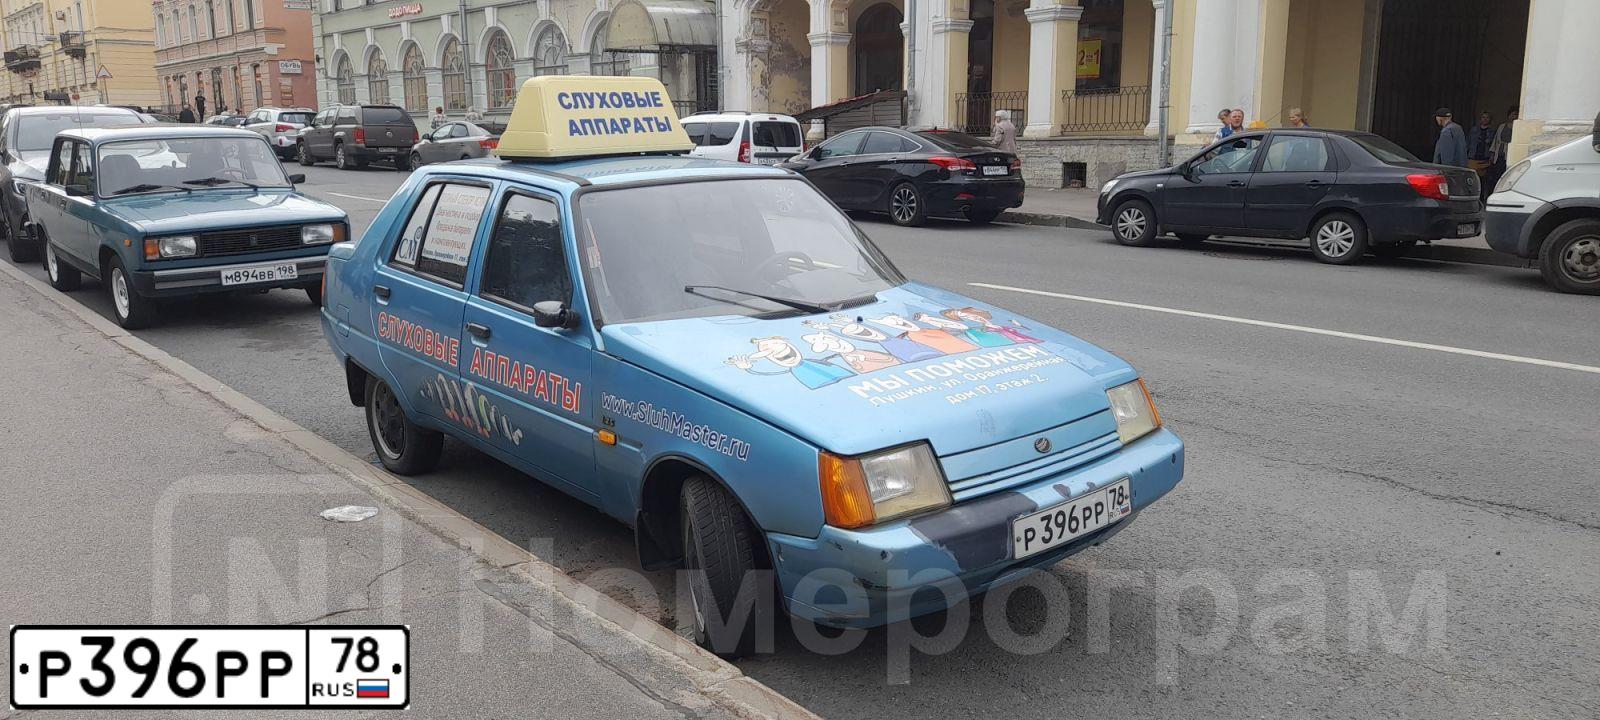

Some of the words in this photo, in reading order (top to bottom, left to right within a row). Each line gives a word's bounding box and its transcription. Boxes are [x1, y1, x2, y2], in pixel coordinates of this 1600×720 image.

[280, 61, 301, 69] ОБУВЬ
[1078, 49, 1086, 66] 2
[557, 91, 664, 110] СЛУХОВЫЕ
[568, 116, 673, 137] АППАРАТЫ
[225, 269, 275, 284] М894ВВ
[276, 265, 294, 275] 198
[378, 311, 460, 367] СЛУХОВЫЕ
[470, 346, 582, 414] АППАРАТЫ
[848, 373, 911, 398] МЫ
[904, 345, 1049, 383] ПОМОЖЕМ
[869, 383, 944, 407] Пушкин,
[941, 377, 967, 389] ул.
[963, 356, 1065, 381] Оранжерейная
[996, 376, 1033, 391] этаж
[601, 391, 750, 461] www.SluhMaster.ru
[1024, 501, 1104, 552] Р396РР
[1109, 485, 1125, 510] 78
